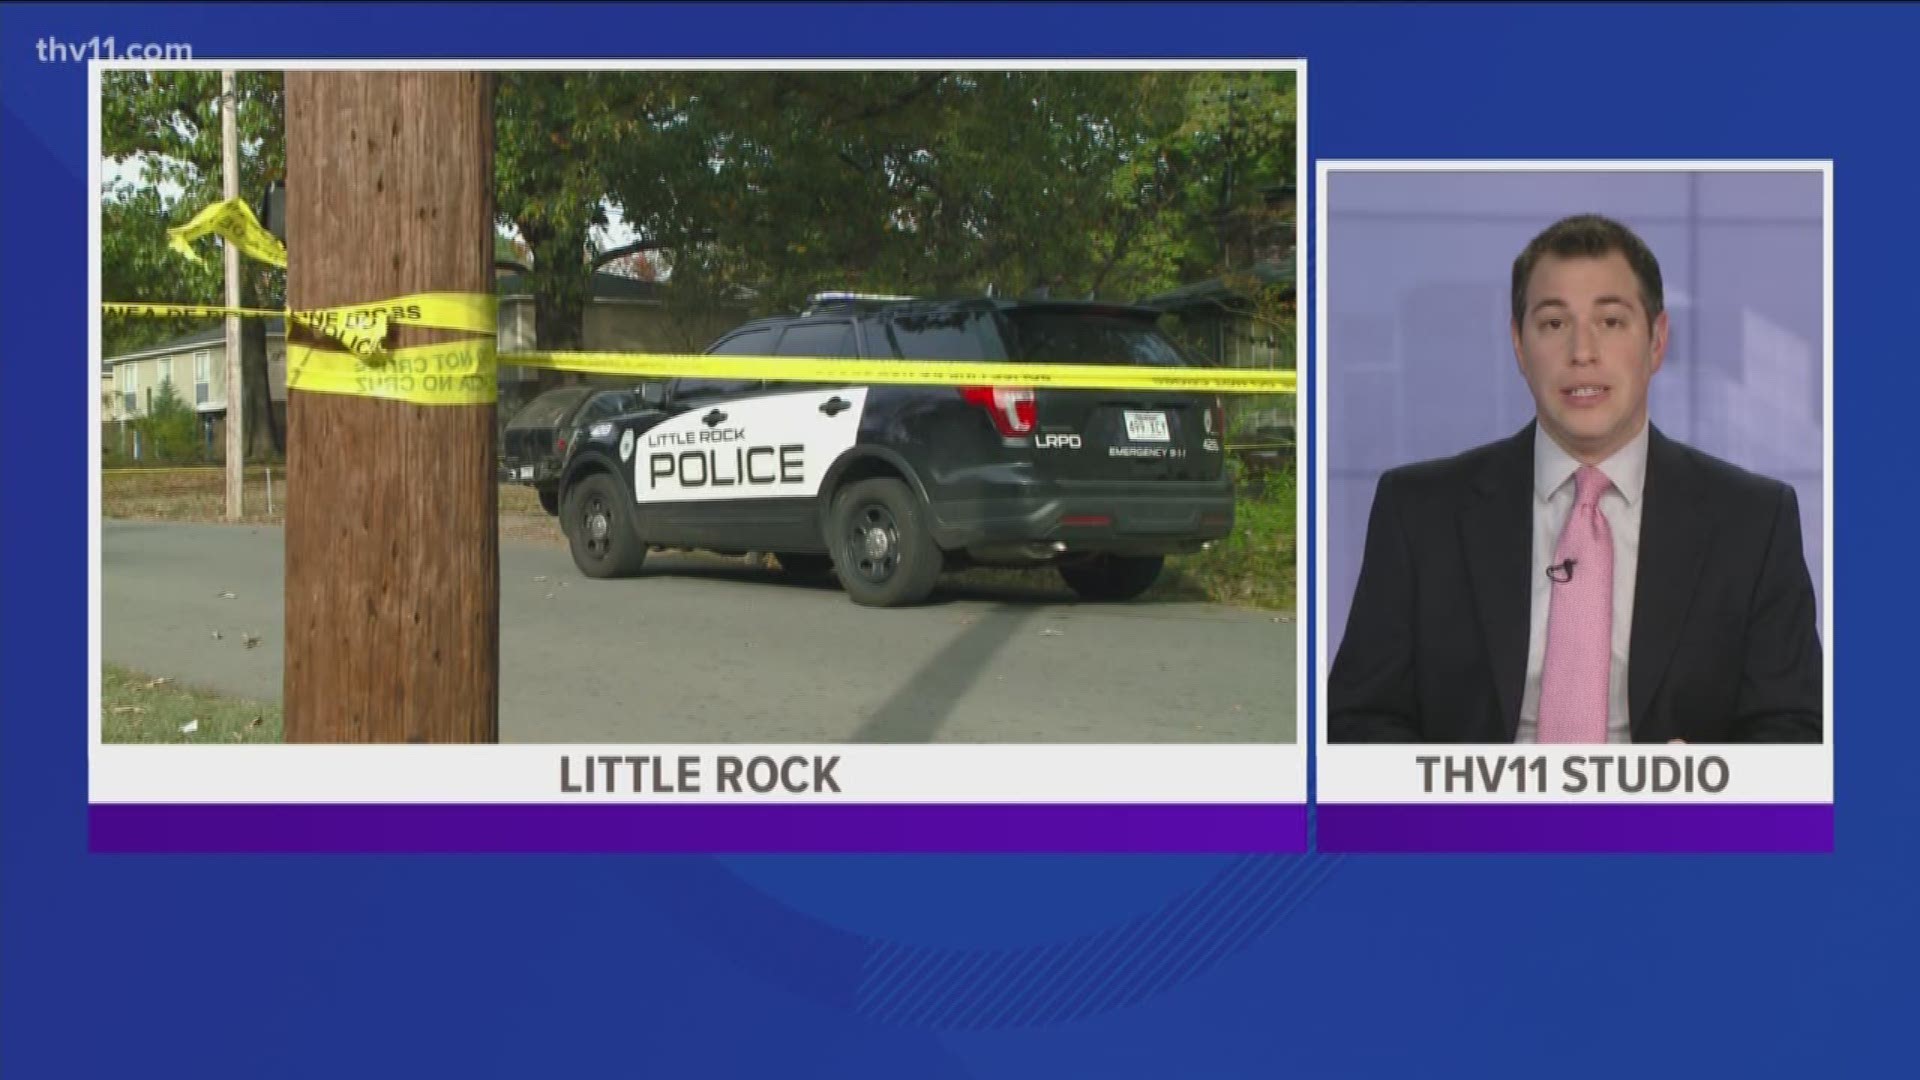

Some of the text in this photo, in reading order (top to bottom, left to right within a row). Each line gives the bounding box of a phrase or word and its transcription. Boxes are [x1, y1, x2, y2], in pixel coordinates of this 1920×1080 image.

[648, 428, 745, 447] LITTLE ROCK
[1035, 434, 1082, 449] LRPD
[1108, 446, 1167, 458] EMERGENCY
[650, 444, 804, 489] POLICE
